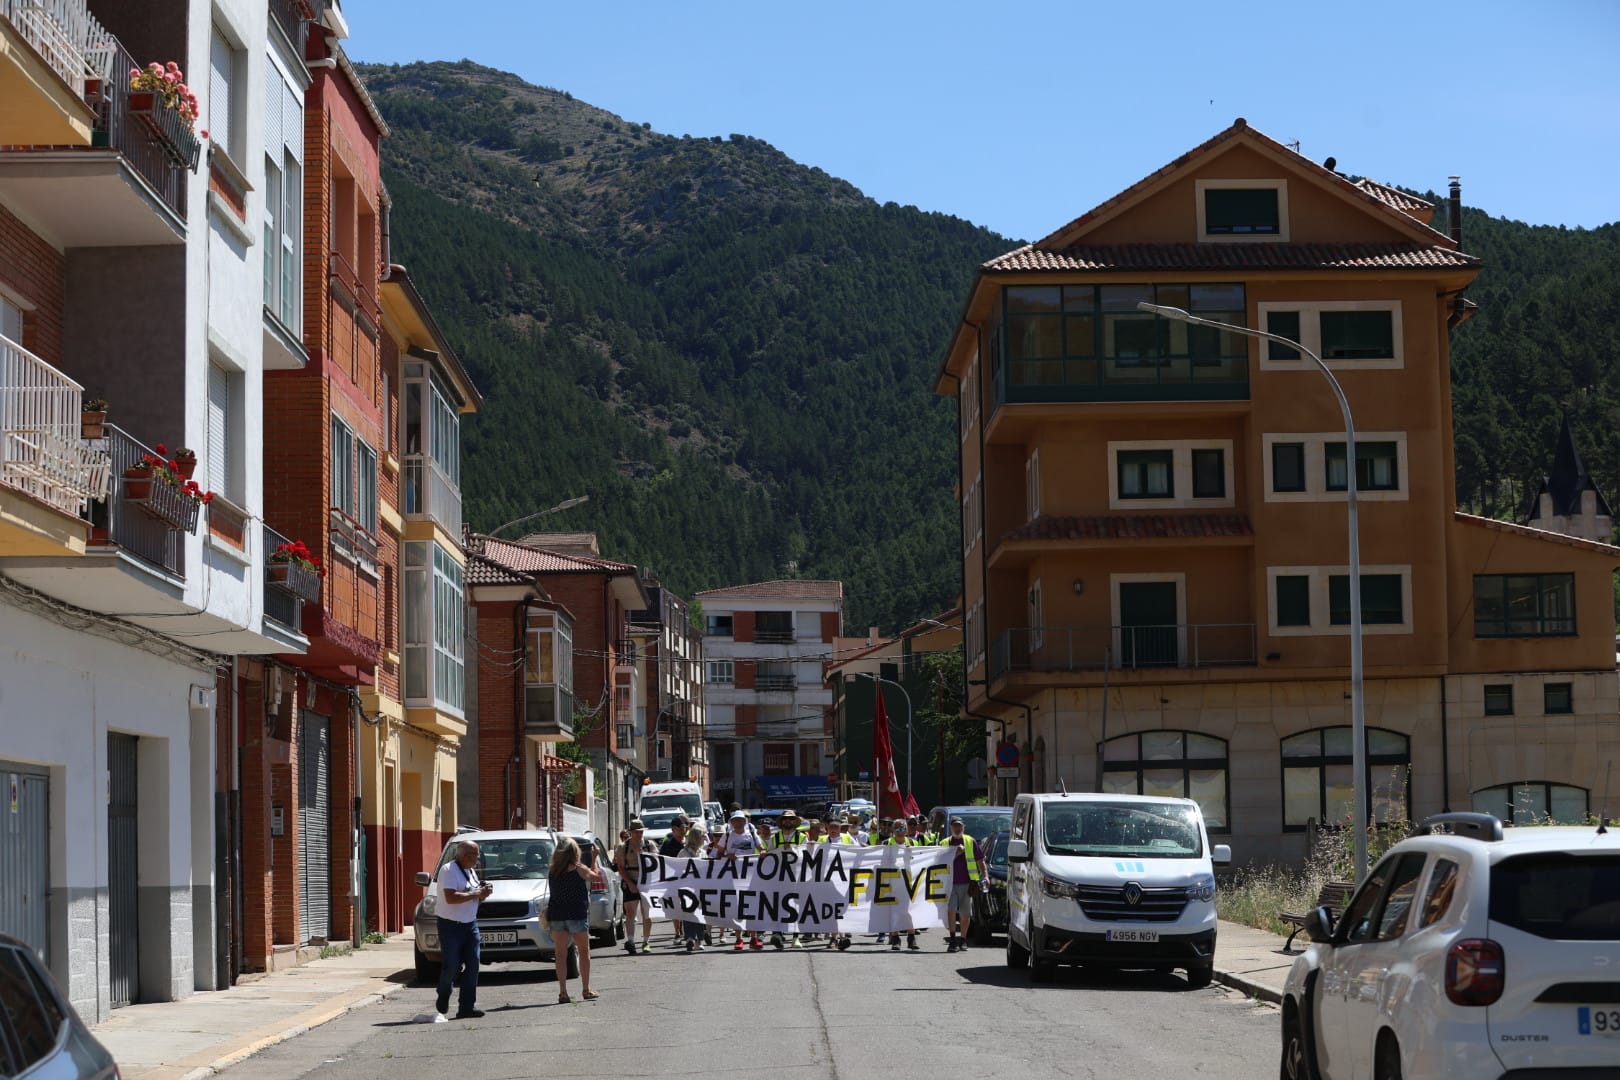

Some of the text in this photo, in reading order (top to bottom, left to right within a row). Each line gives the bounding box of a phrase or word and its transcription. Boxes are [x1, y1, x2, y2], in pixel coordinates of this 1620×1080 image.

[639, 849, 848, 885] PLATAFORMA
[848, 863, 951, 907] FEVE
[649, 888, 845, 924] EN DEFENSA DE
[1112, 930, 1158, 941] 4956 NGY
[1500, 1033, 1550, 1042] DUSTER
